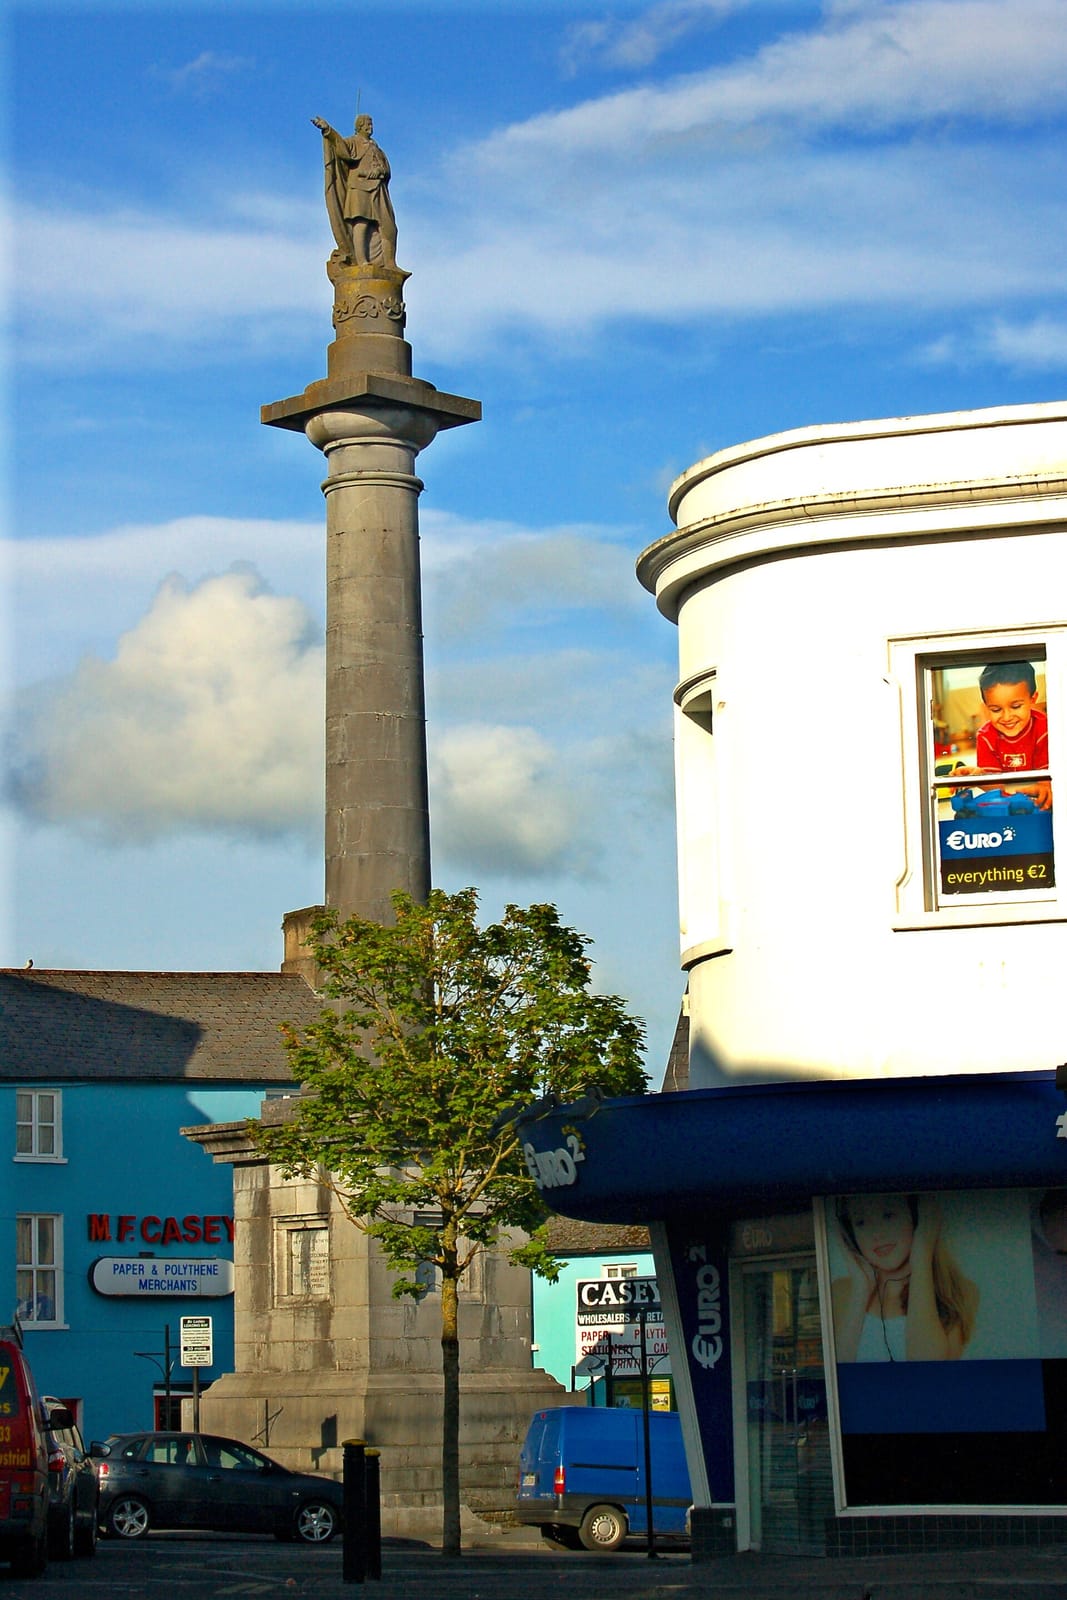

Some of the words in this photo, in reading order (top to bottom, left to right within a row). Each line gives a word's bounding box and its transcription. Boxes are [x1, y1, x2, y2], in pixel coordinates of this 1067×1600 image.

[947, 867, 1024, 885] everything
[1027, 864, 1047, 879] €2
[140, 1214, 235, 1245] CASEY
[113, 1263, 145, 1276] PAPER
[151, 1264, 158, 1276] &
[165, 1263, 219, 1276] POLYTHENE
[139, 1279, 198, 1291] MERCHANTS
[577, 1312, 631, 1326] WHOLESALERS
[581, 1330, 609, 1342] PAPER
[634, 1328, 667, 1341] PLYTH
